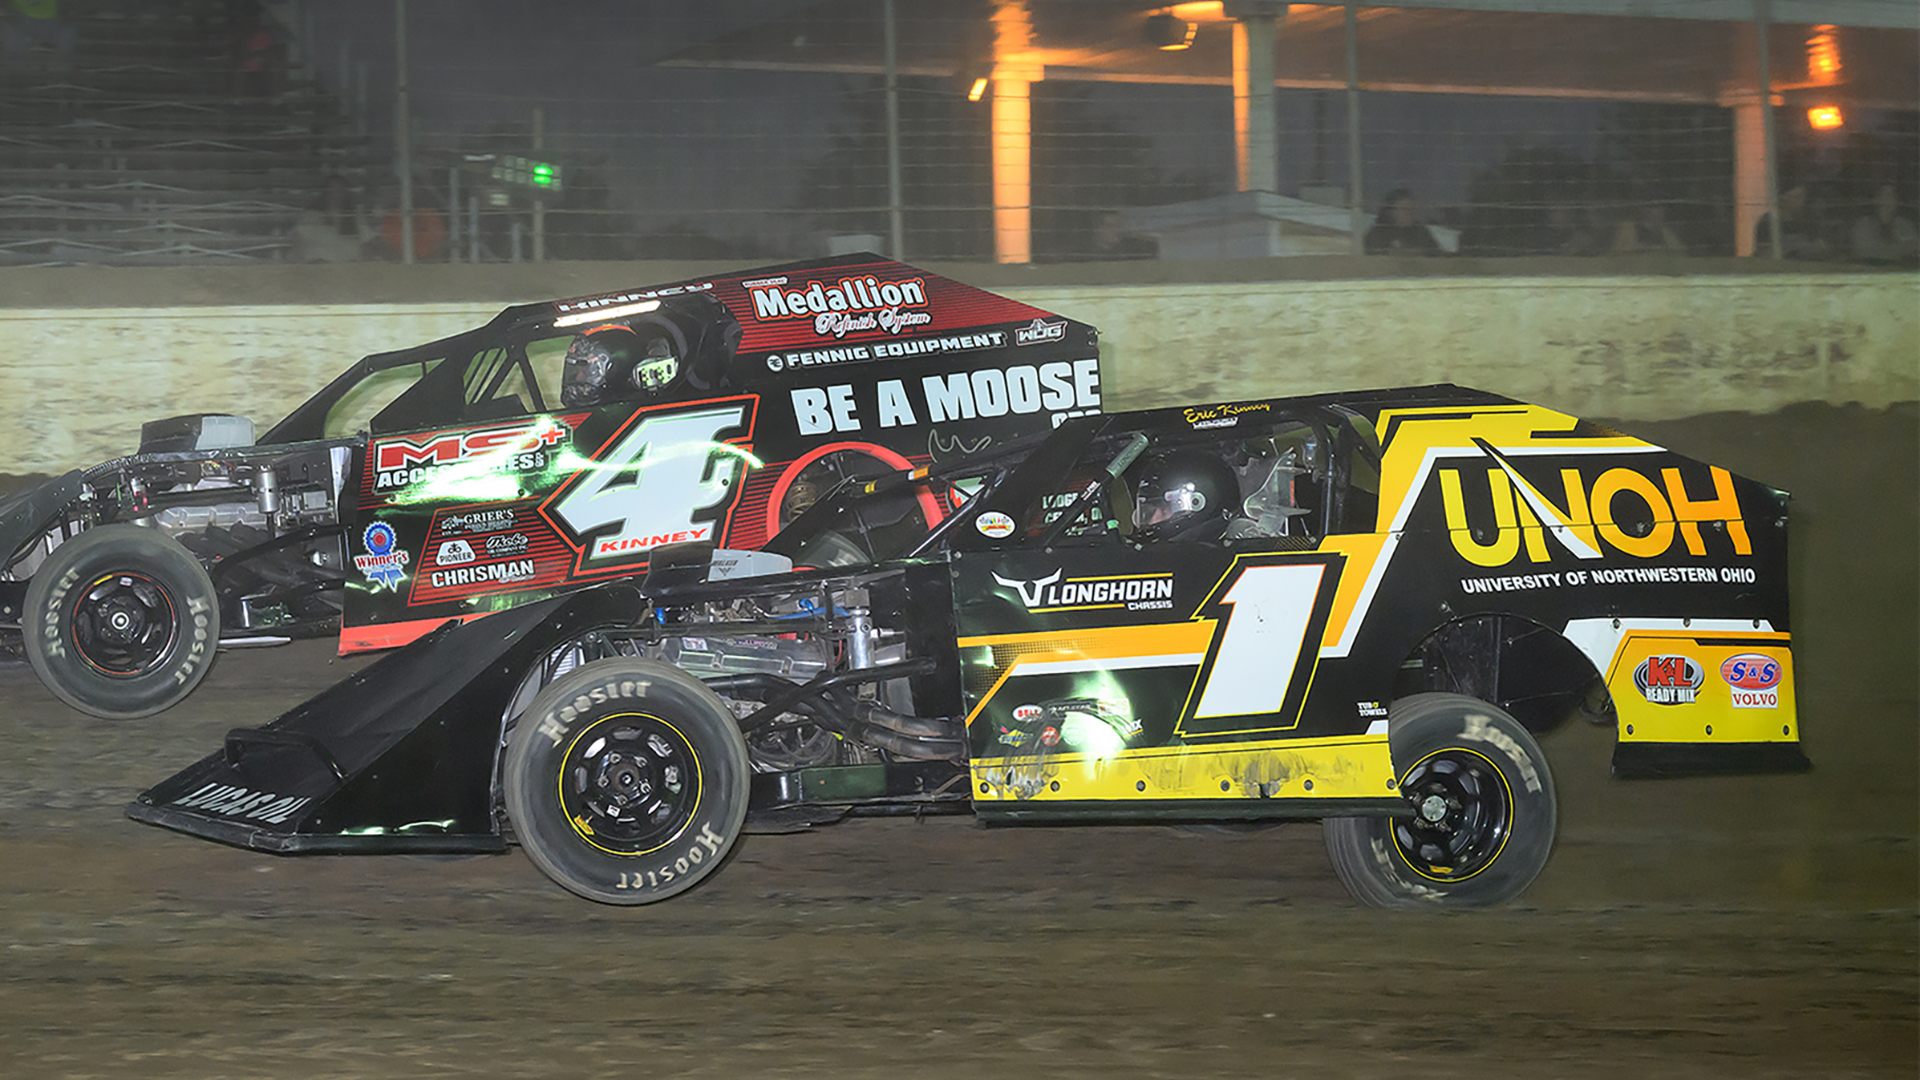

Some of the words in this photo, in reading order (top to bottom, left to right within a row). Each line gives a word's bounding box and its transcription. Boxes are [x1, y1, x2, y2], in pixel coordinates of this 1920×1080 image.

[753, 278, 924, 318] Medallion
[878, 307, 931, 334] System
[786, 347, 870, 367] FENNIG
[874, 333, 1003, 357] EQUIPMENT
[790, 384, 861, 435] BE
[877, 379, 917, 427] A
[922, 359, 1100, 423] MOOSE
[1183, 408, 1217, 423] Eric
[557, 407, 744, 560] 4
[463, 508, 515, 524] GRIER'S
[1439, 465, 1752, 567] UNOH
[600, 528, 708, 552] KINNEY
[356, 552, 408, 568] Winner's
[440, 552, 473, 564] PIONEER
[432, 560, 535, 588] CHRISMAN
[1461, 573, 1560, 594] UNIVERSITY
[1566, 571, 1588, 585] OF
[1592, 567, 1718, 584] NORTHWESTERN
[1721, 568, 1756, 583] OHIO
[1048, 579, 1173, 605] LONGHORN
[1127, 600, 1173, 610] CHASSIS
[174, 595, 211, 685] Hoosier
[1193, 564, 1327, 719] 1
[1648, 657, 1692, 686] K&L
[1646, 688, 1675, 702] READY
[1676, 688, 1696, 702] MIX
[1733, 693, 1777, 706] VOLVO
[537, 681, 652, 748] Hoosier
[1017, 709, 1041, 718] BELL
[617, 821, 725, 891] Hoosier
